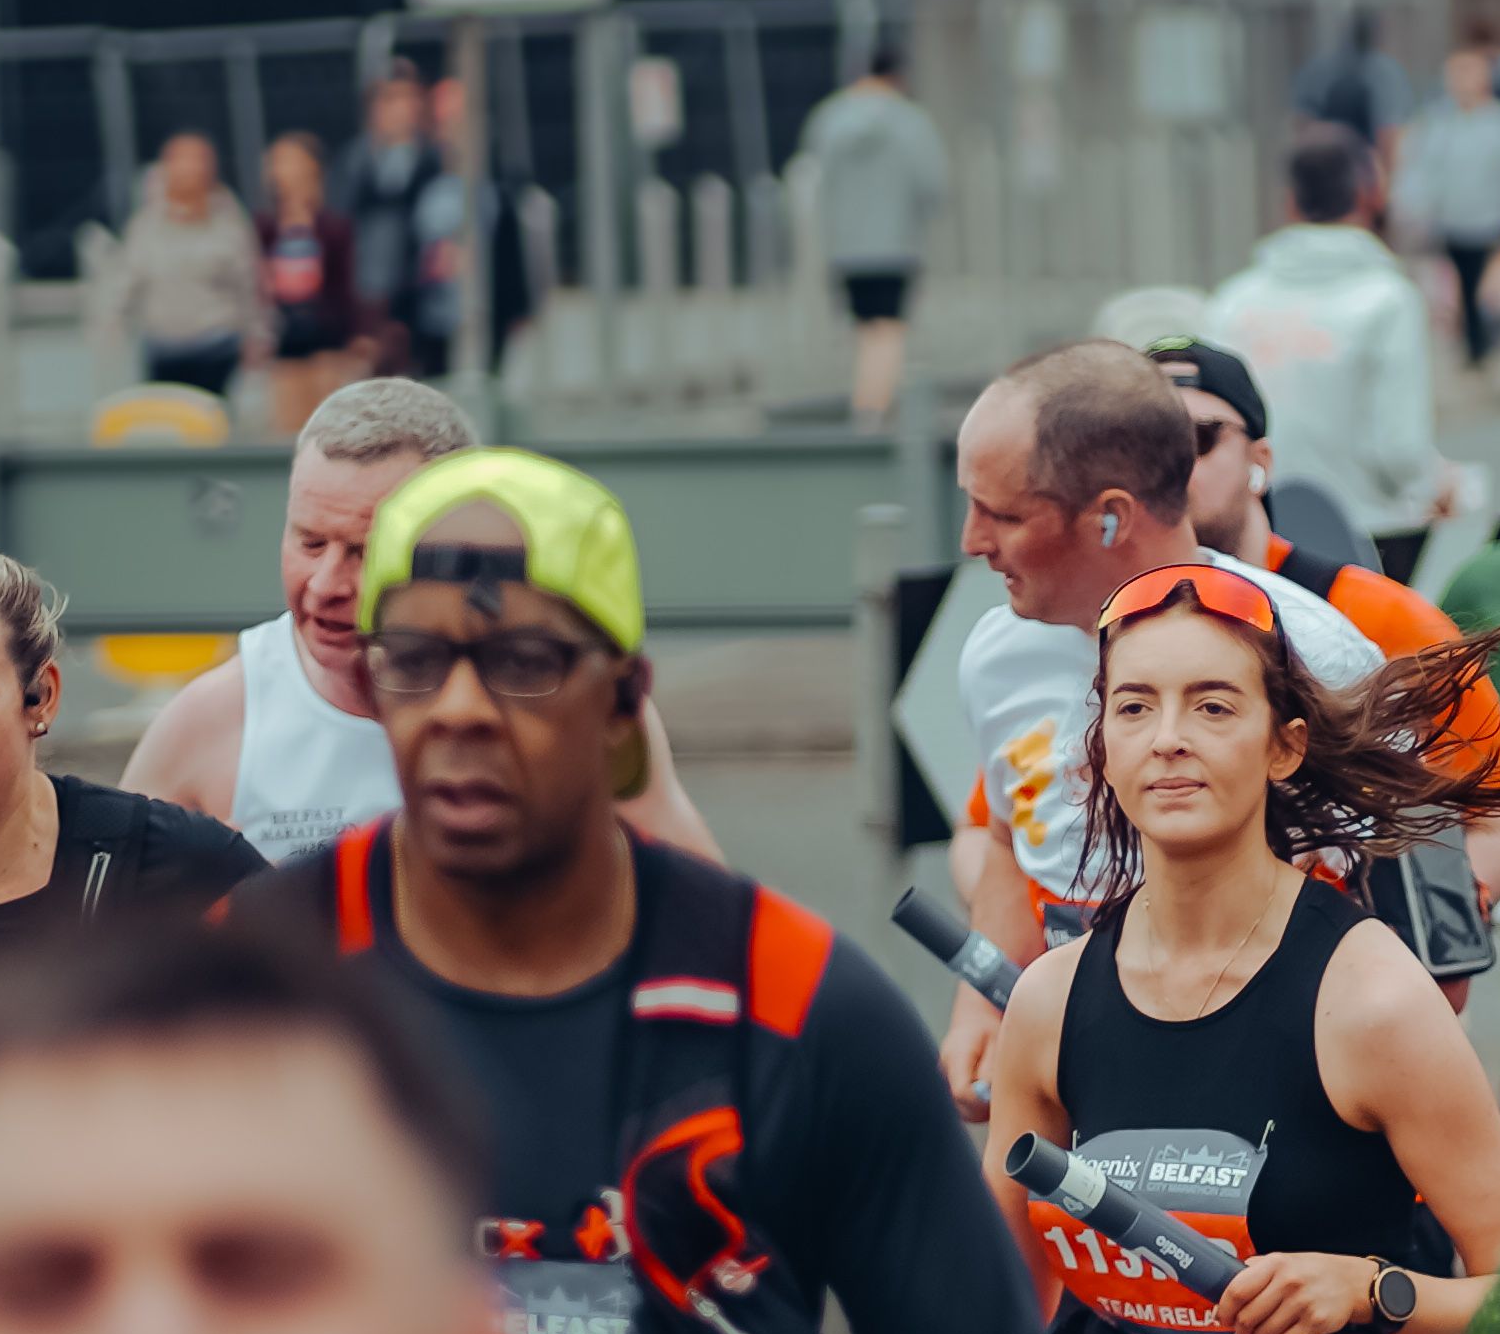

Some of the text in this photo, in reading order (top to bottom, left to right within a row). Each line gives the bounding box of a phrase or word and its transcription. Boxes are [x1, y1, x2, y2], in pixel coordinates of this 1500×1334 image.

[1148, 1162, 1248, 1188] BELFAST
[1155, 1235, 1195, 1269] Radio
[1097, 1296, 1221, 1327] TEAM RELA
